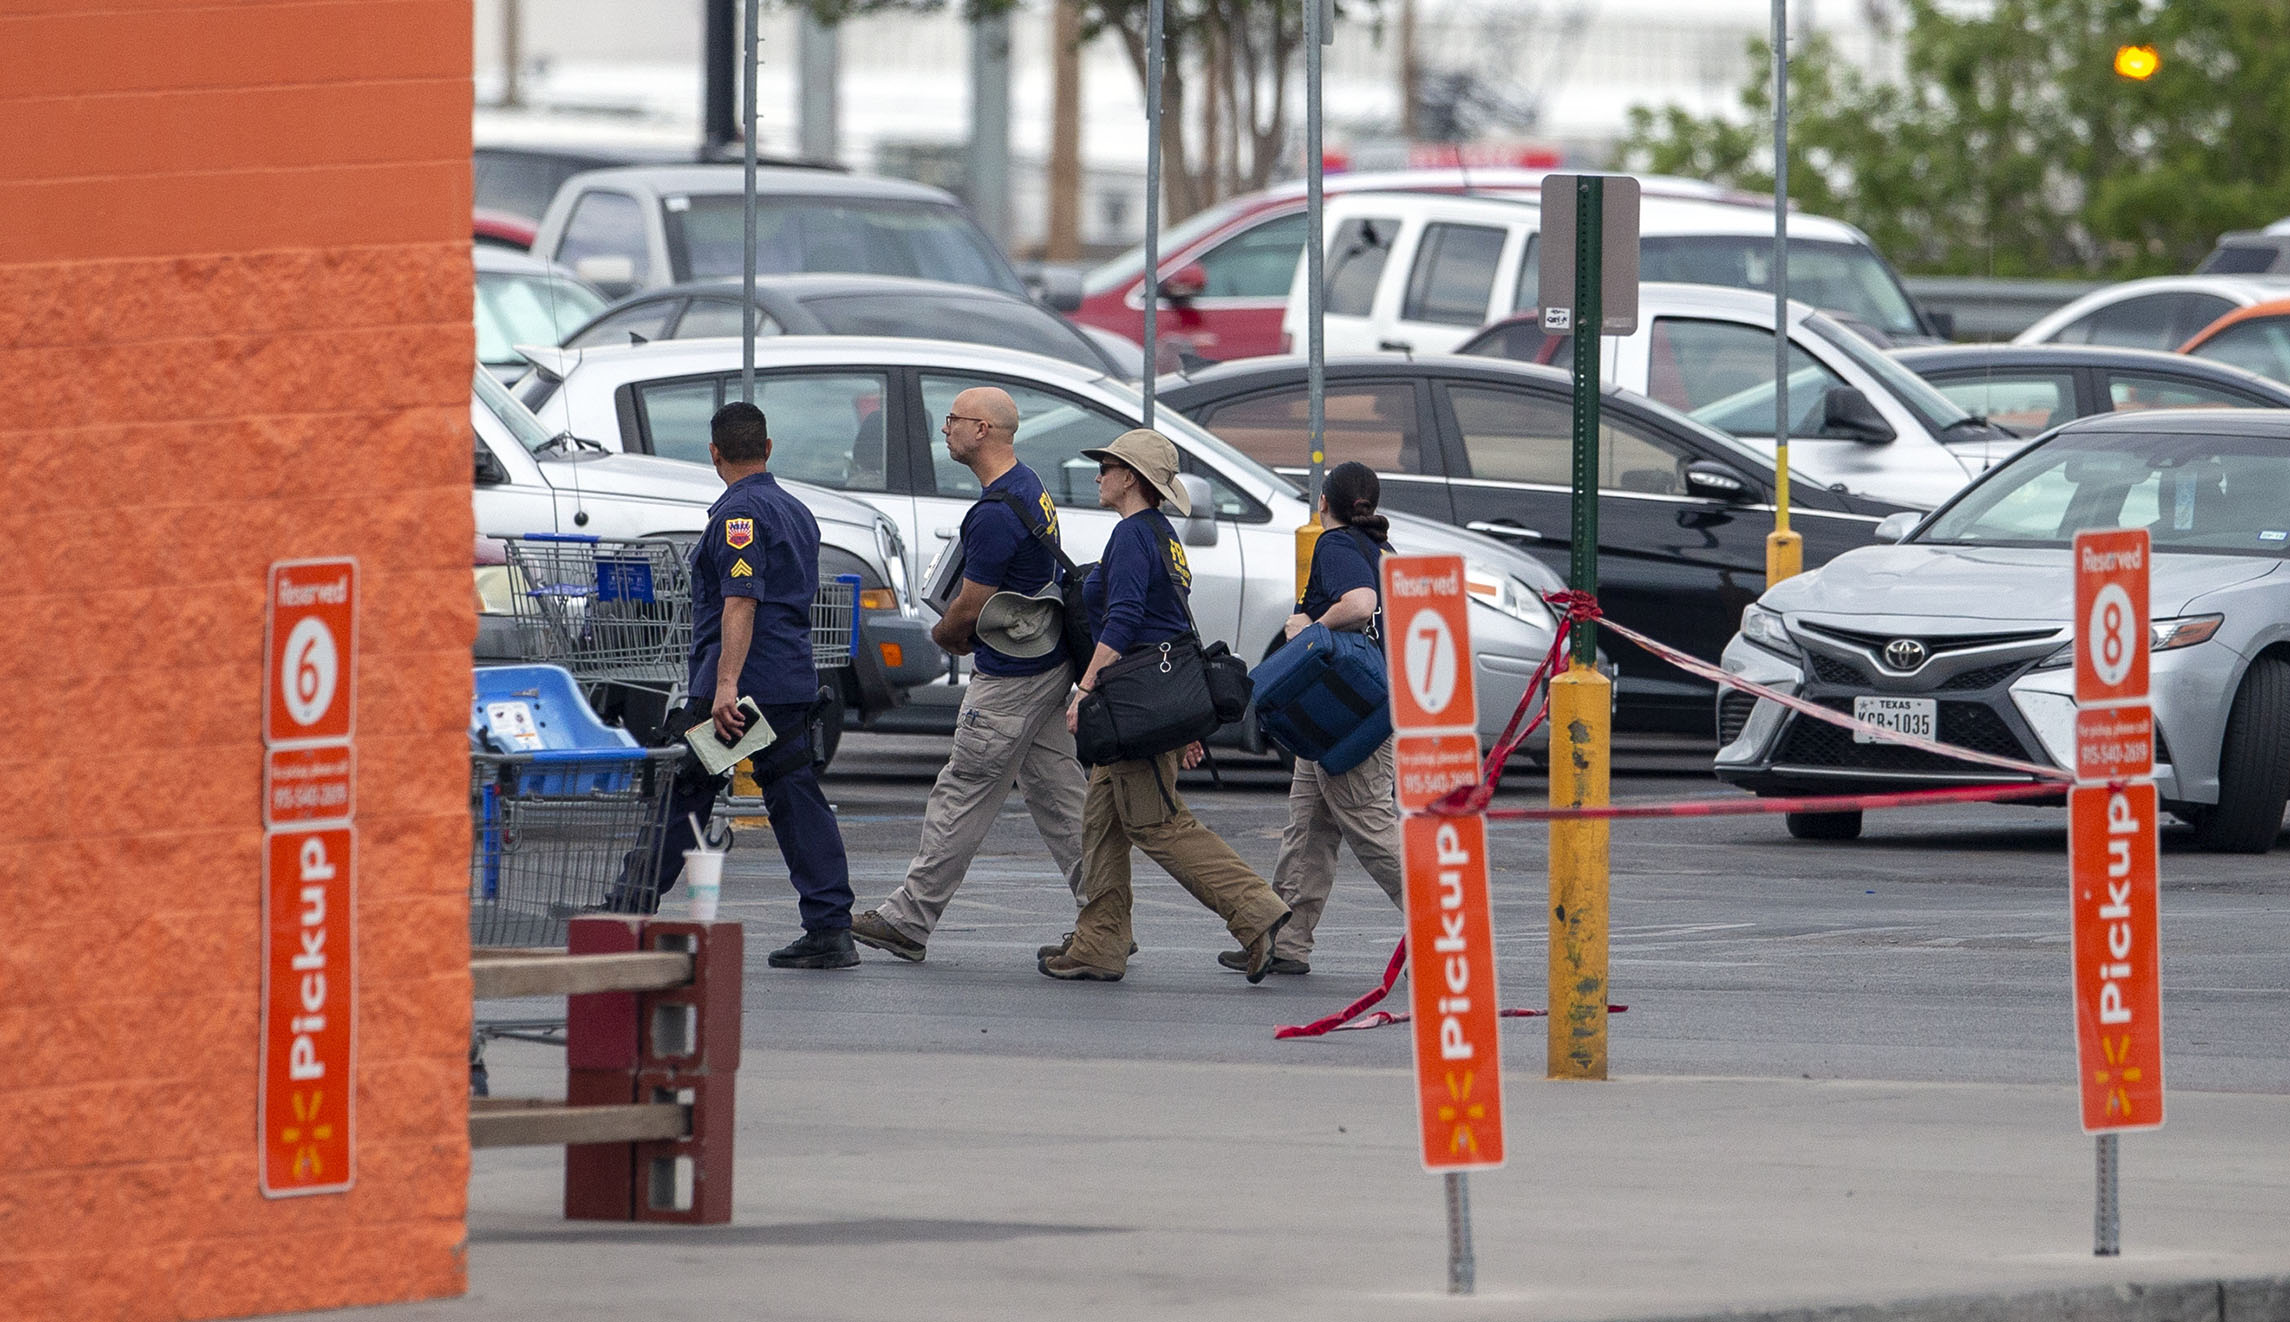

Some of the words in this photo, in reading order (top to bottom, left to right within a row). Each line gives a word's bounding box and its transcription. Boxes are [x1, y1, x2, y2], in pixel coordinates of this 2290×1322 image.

[1169, 537, 1188, 567] FB
[1392, 569, 1459, 598] Reserved
[2082, 544, 2142, 574] Reserved
[277, 573, 347, 608] Reserved
[1418, 628, 1439, 695] 7
[2103, 601, 2122, 667] 8
[296, 635, 319, 705] 6
[1880, 700, 1912, 710] TEXAS
[1433, 822, 1474, 1060] Pickup
[2099, 793, 2140, 1024] Pickup
[289, 836, 336, 1081] Pickup
